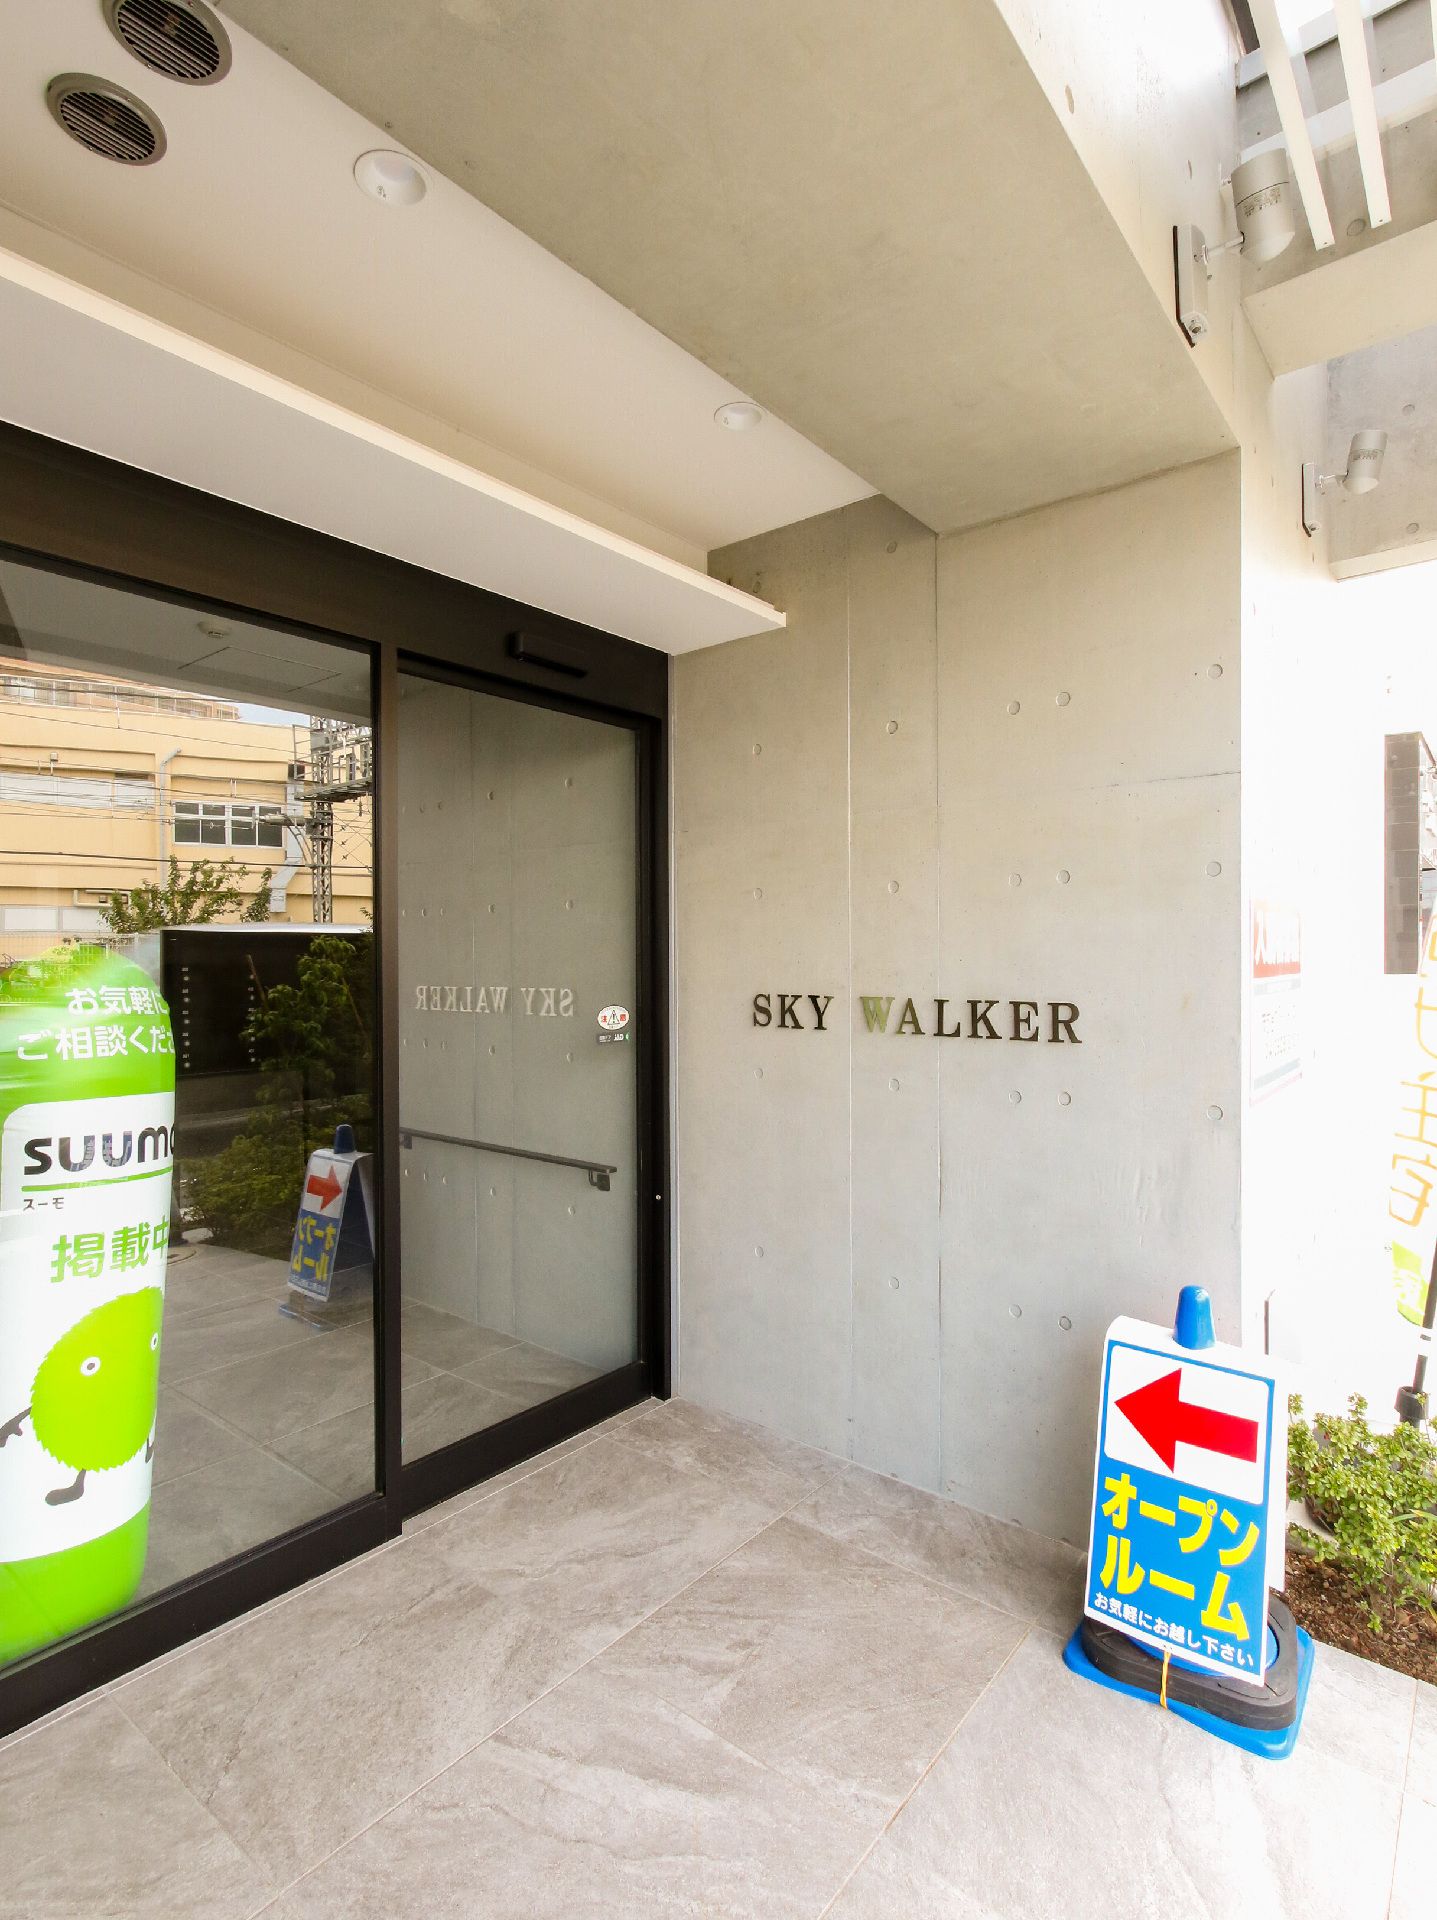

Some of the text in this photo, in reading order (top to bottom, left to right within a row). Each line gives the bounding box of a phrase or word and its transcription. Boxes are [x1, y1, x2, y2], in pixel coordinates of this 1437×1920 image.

[65, 986, 168, 1016] お気軽に
[753, 994, 1083, 1043] SKY WALKER
[24, 1125, 174, 1175] suum
[23, 1197, 65, 1211] スーモ
[51, 1216, 169, 1283] 掲載中
[1102, 1473, 1260, 1566] オープン
[1100, 1535, 1250, 1641] ルーム
[1094, 1592, 1254, 1667] お気軽にお越し下さい
